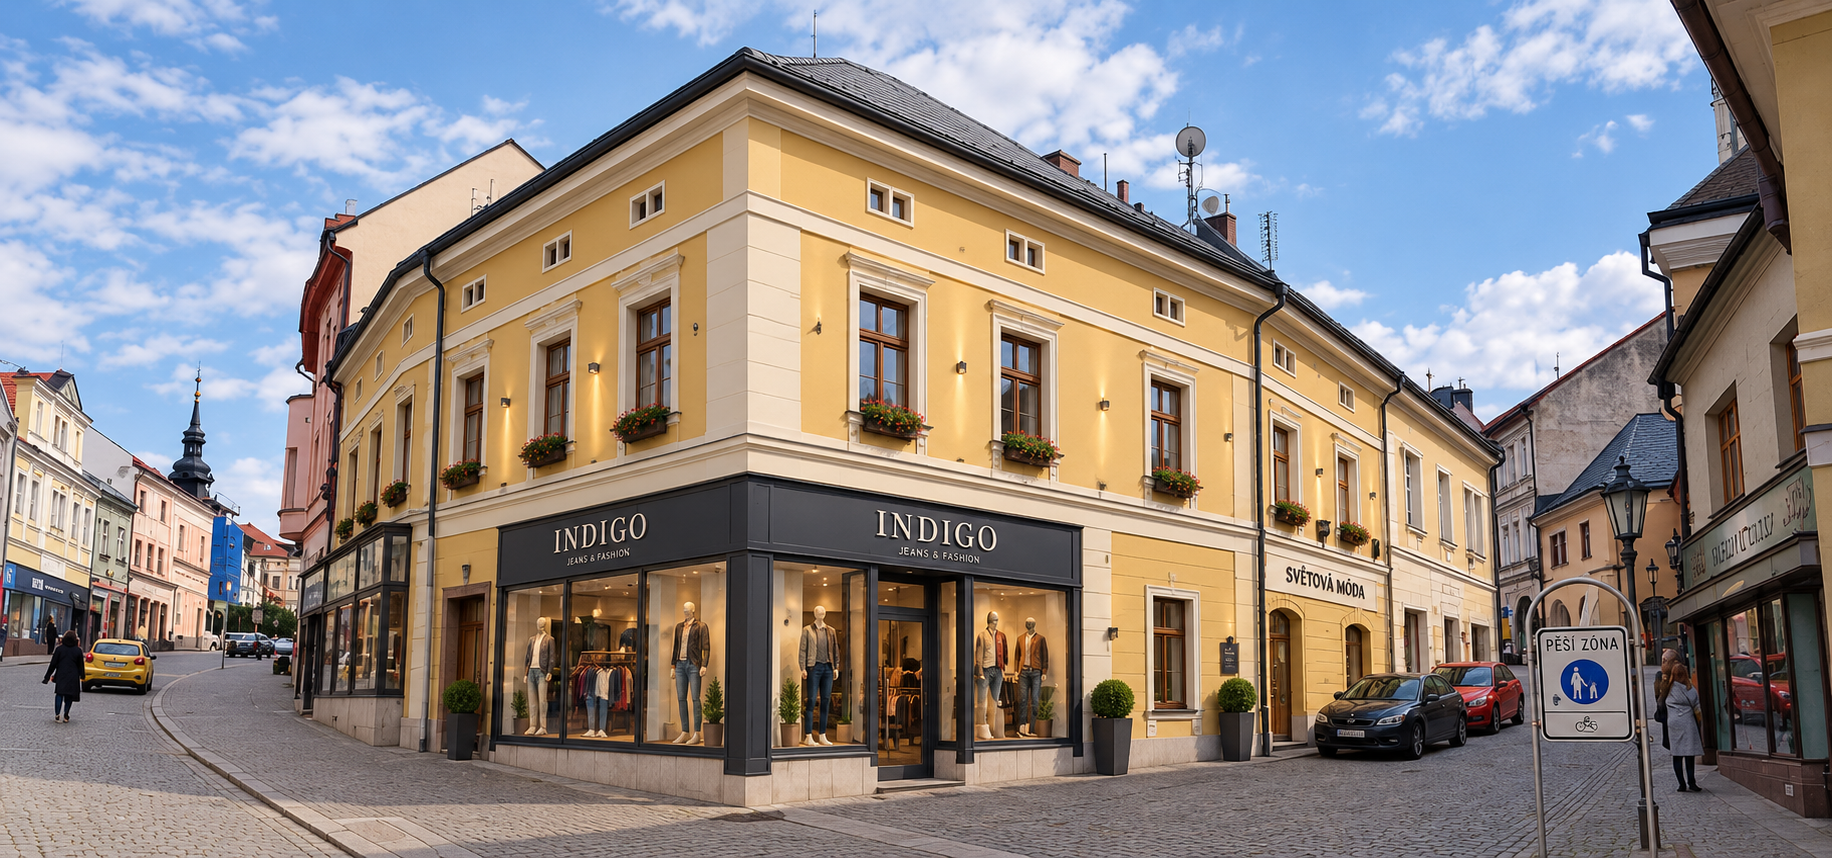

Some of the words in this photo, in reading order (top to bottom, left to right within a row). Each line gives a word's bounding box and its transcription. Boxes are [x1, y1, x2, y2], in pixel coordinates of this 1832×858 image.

[553, 512, 647, 554] INDIGO
[876, 509, 998, 552] INDIGO
[566, 554, 588, 567] JEANS
[589, 554, 595, 562] &
[597, 547, 631, 561] FASHION
[899, 546, 929, 558] JEANS
[932, 550, 939, 559] &
[942, 551, 980, 564] FASHION
[1581, 634, 1619, 651] ZÓNA
